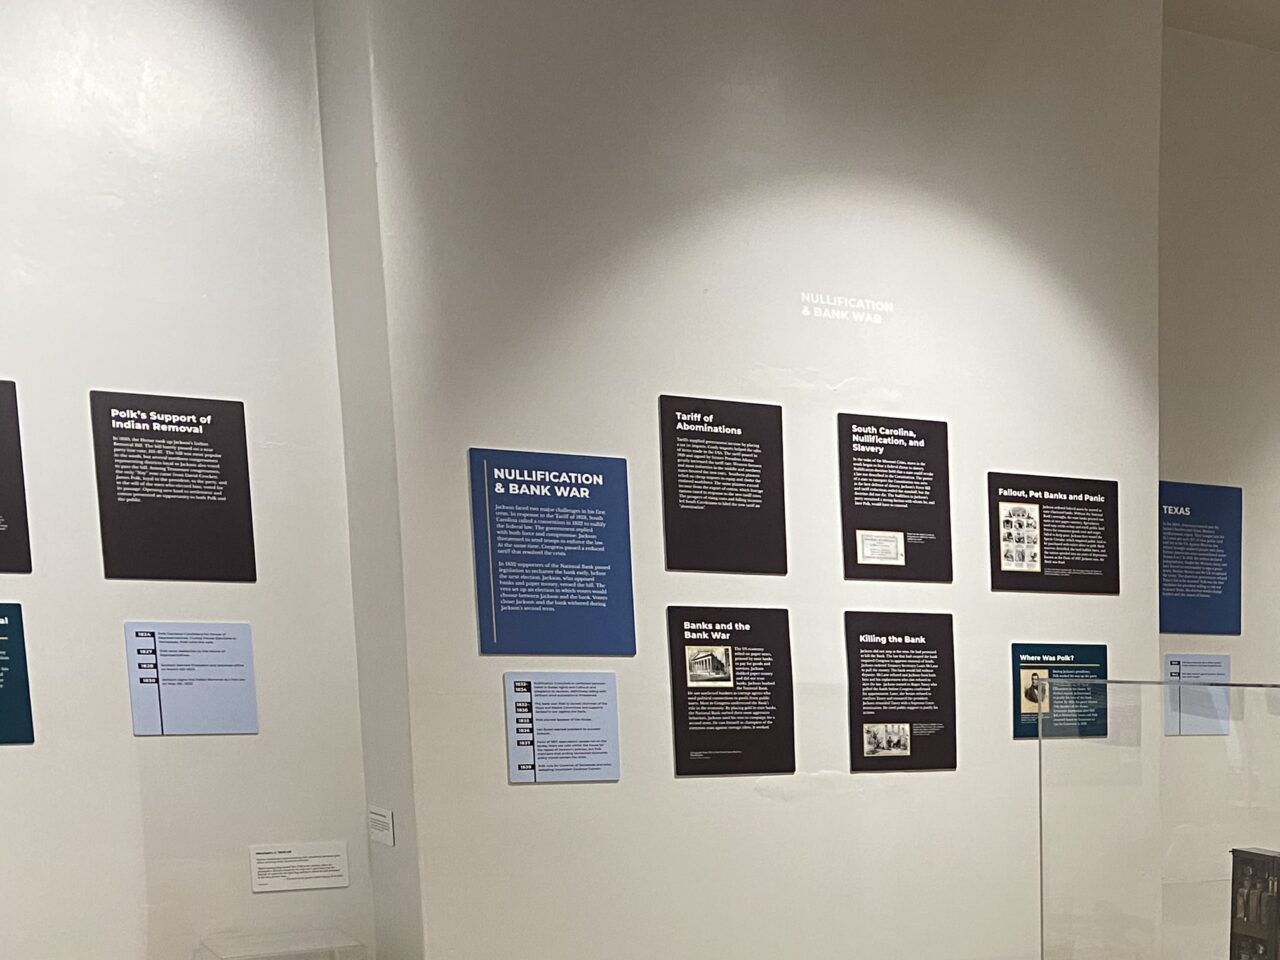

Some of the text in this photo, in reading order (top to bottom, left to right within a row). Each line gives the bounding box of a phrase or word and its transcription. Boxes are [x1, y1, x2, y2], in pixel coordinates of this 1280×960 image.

[801, 292, 894, 312] NULLIFICATION
[802, 305, 882, 324] & BANK WAR
[111, 408, 212, 424] Polk's Support of
[676, 412, 714, 422] Tariff of
[112, 420, 203, 434] Indian Removal
[676, 422, 742, 435] Abominations
[852, 425, 916, 437] South Carolina,
[852, 435, 925, 447] Nullification, and
[852, 444, 884, 454] Slavery
[493, 468, 604, 485] NULLIFICATION
[495, 483, 590, 498] & BANK WAR
[999, 488, 1028, 498] Fallout,
[1044, 492, 1067, 500] Banks
[1163, 505, 1191, 515] TEXAS
[683, 622, 750, 631] Banks and the
[684, 631, 731, 640] Bank War
[859, 634, 886, 644] Killing
